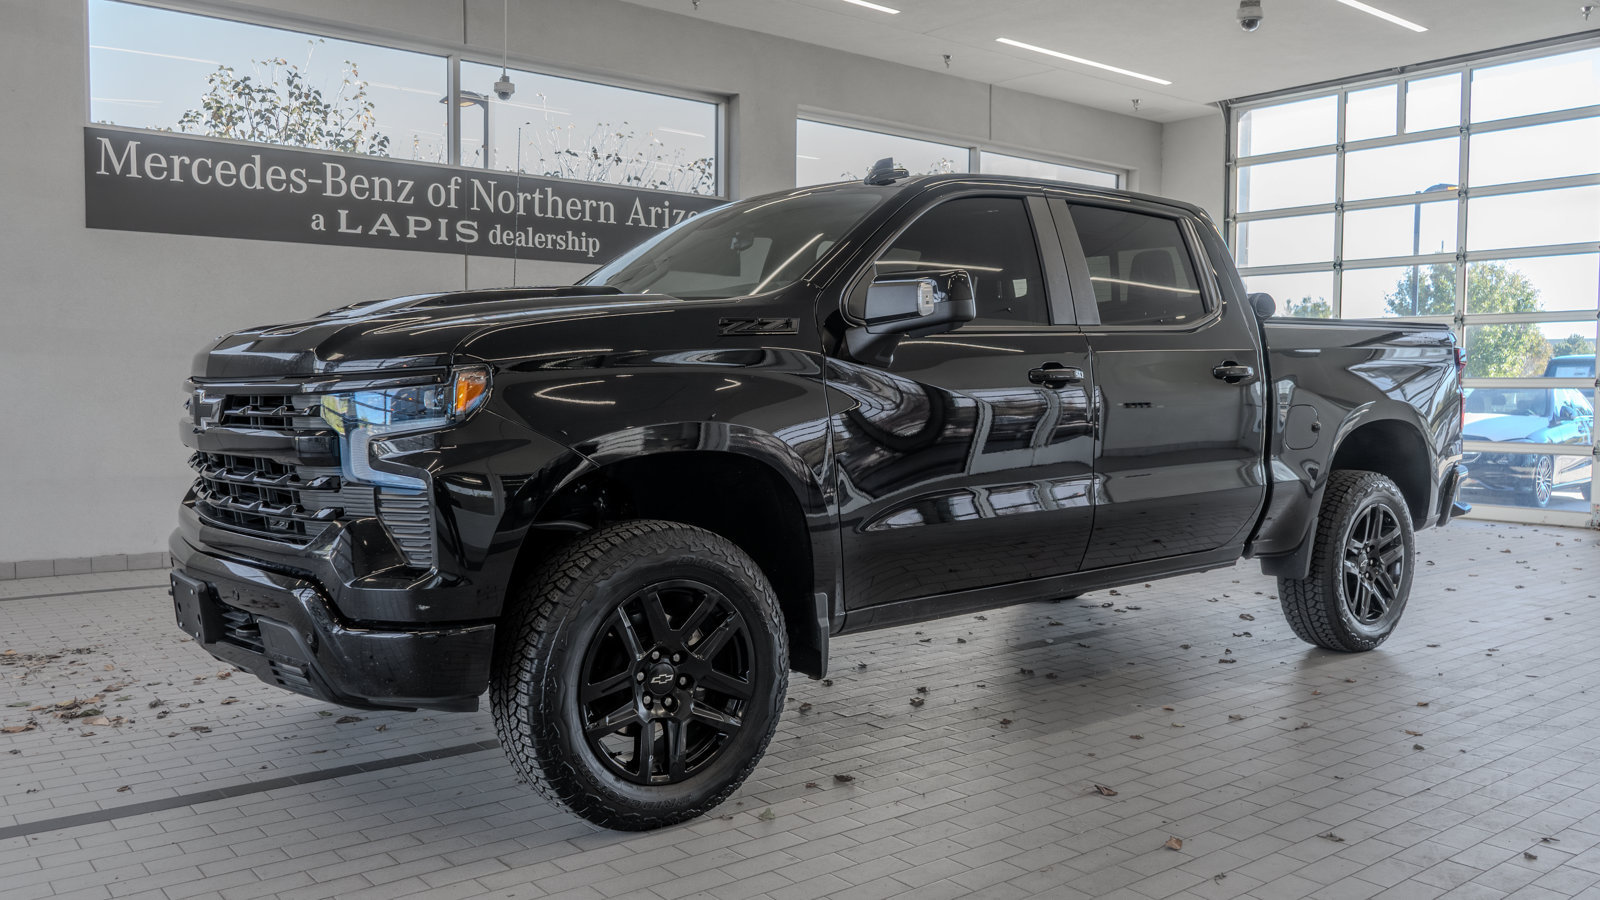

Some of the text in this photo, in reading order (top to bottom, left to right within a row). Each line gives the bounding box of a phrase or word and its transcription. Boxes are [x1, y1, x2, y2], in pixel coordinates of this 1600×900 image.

[96, 137, 414, 204] Mercedes-Benz
[428, 176, 461, 209] of
[470, 178, 617, 225] Northern
[311, 209, 600, 257] a LAPIS dealership
